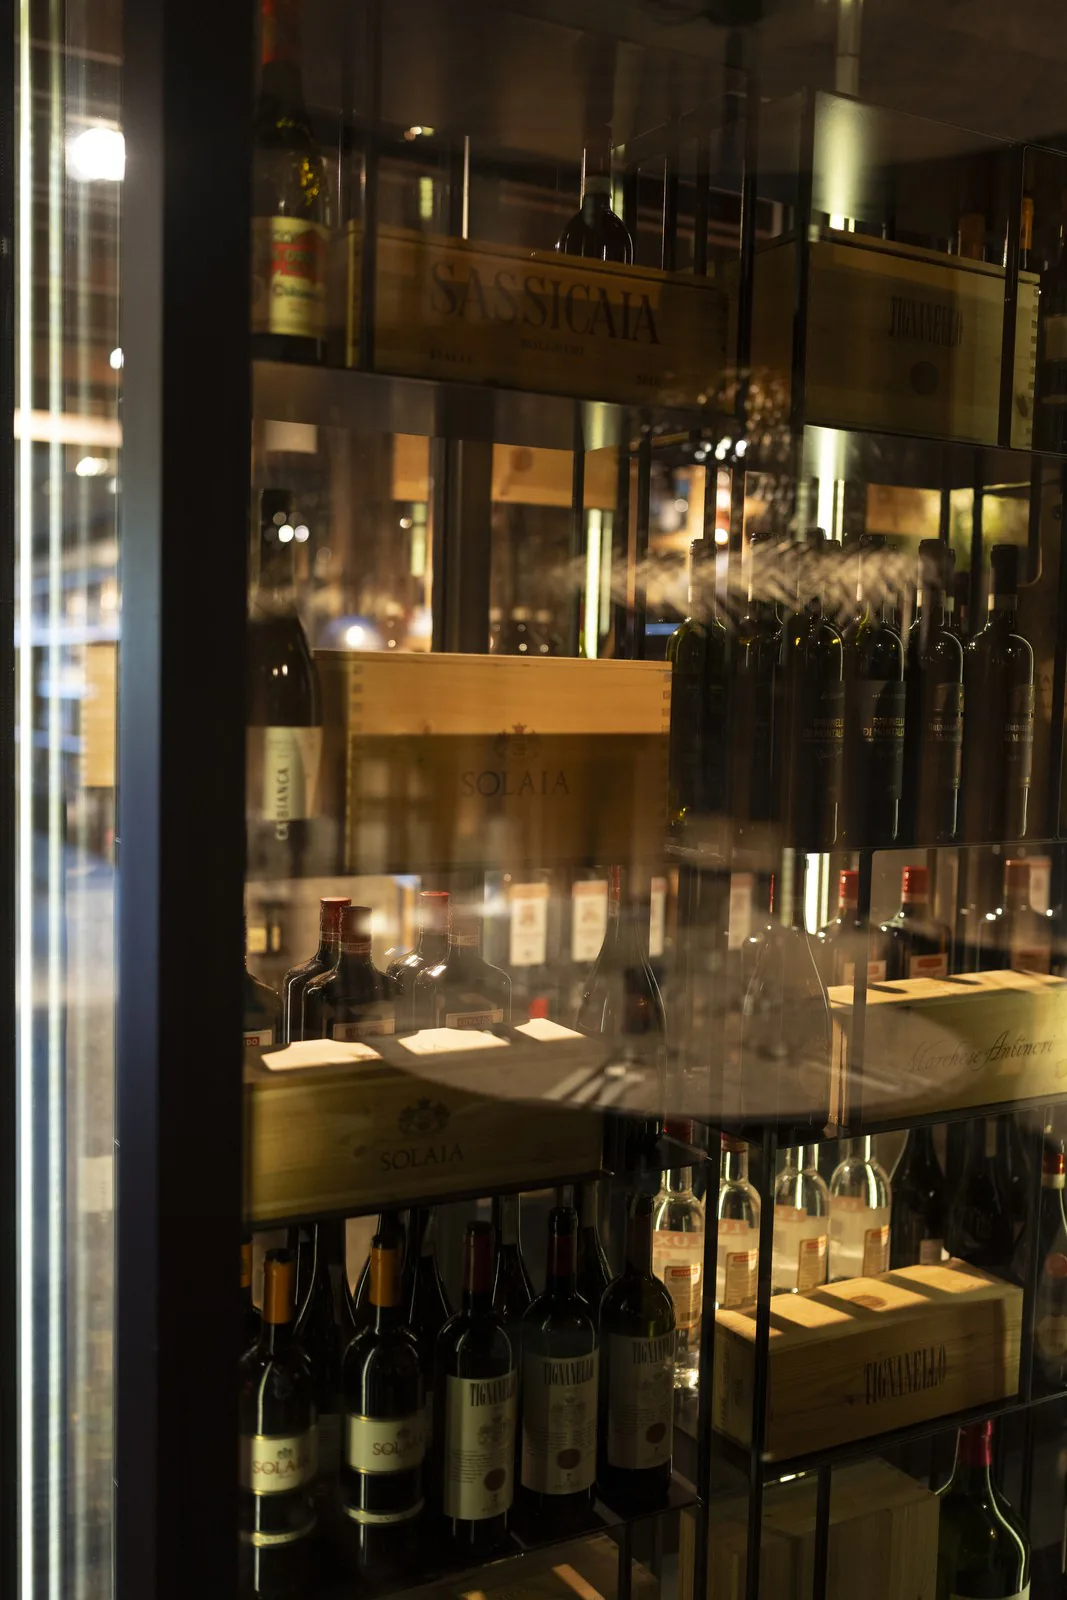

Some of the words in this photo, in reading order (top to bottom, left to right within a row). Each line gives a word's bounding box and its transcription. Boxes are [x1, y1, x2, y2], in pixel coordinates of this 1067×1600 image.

[431, 262, 661, 345] SASSICAIA
[461, 769, 572, 797] SOLAIA
[969, 1030, 1056, 1072] Antinori
[379, 1143, 464, 1172] SOLAIA
[544, 1358, 595, 1386] TIGNANELLO
[863, 1344, 947, 1406] TIGNANELLO
